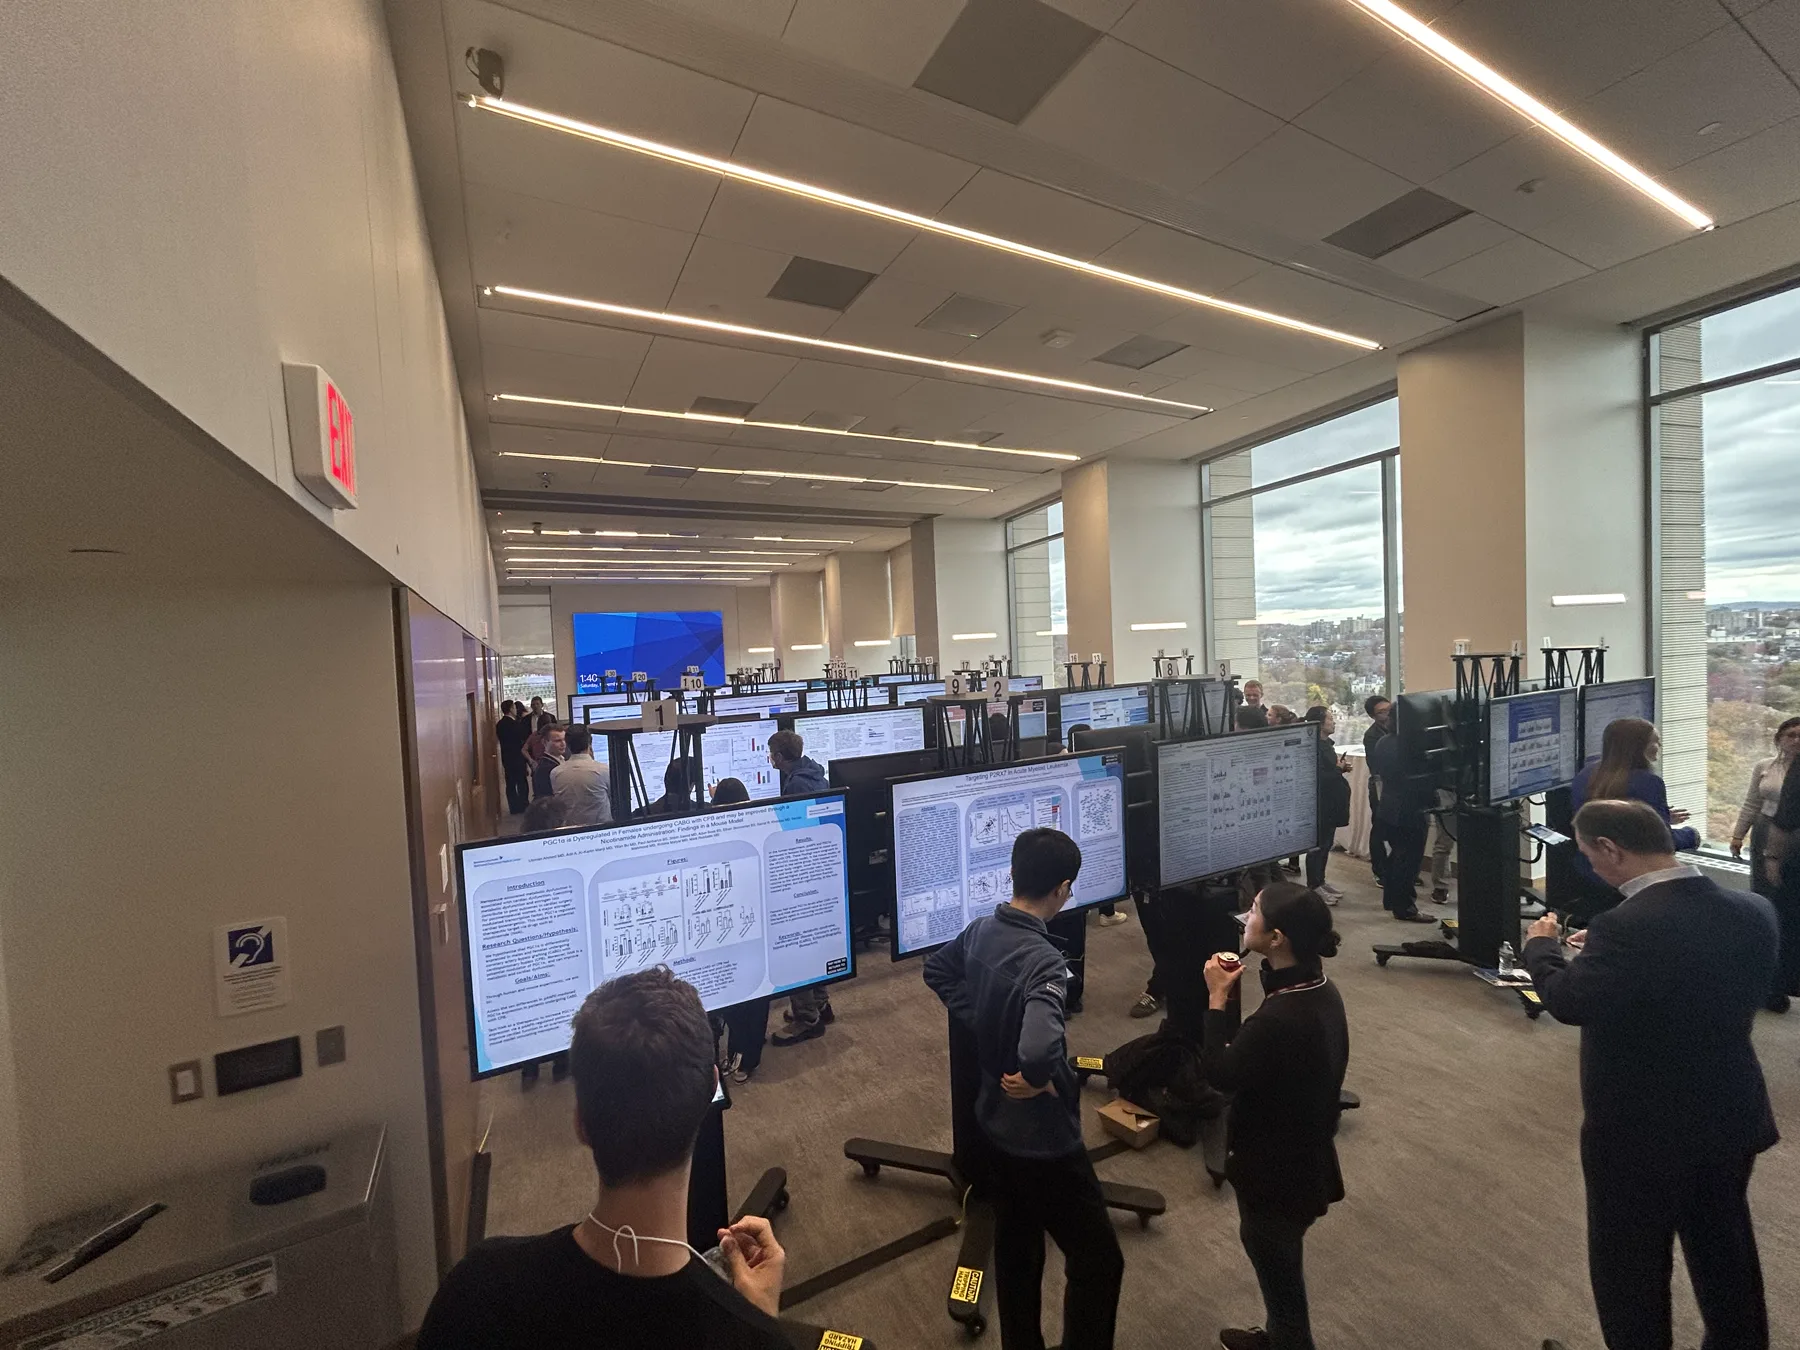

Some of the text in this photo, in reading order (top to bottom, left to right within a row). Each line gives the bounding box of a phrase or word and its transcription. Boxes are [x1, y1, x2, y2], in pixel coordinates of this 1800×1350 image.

[327, 382, 355, 496] EXIT
[1093, 654, 1100, 662] 13
[834, 670, 842, 678] 18
[850, 670, 858, 678] 11
[1167, 663, 1174, 676] 8
[1219, 663, 1226, 677] 3
[690, 678, 702, 689] 10
[952, 679, 960, 694] 9
[993, 681, 1002, 698] 2
[655, 705, 664, 726] 1
[965, 772, 989, 782] Targeting
[1014, 766, 1028, 774] Acute
[572, 831, 611, 842] Dysregulated
[618, 827, 642, 836] Females
[642, 822, 673, 832] undergoing
[674, 819, 691, 827] CABG
[726, 812, 738, 820] may
[745, 808, 768, 816] improved
[768, 804, 786, 812] through
[600, 834, 636, 844] Nicotinamide
[637, 828, 676, 839] Administration:
[677, 824, 700, 834] Findings
[710, 820, 728, 828] Mouse
[506, 880, 546, 892] Introduction
[482, 940, 511, 950] Research
[515, 972, 551, 984] Goals/Aims:
[954, 1270, 964, 1294] HAZARD
[958, 1271, 970, 1298] TRIPPING
[965, 1272, 980, 1301] CAUTION
[828, 1333, 857, 1344] HAZARD
